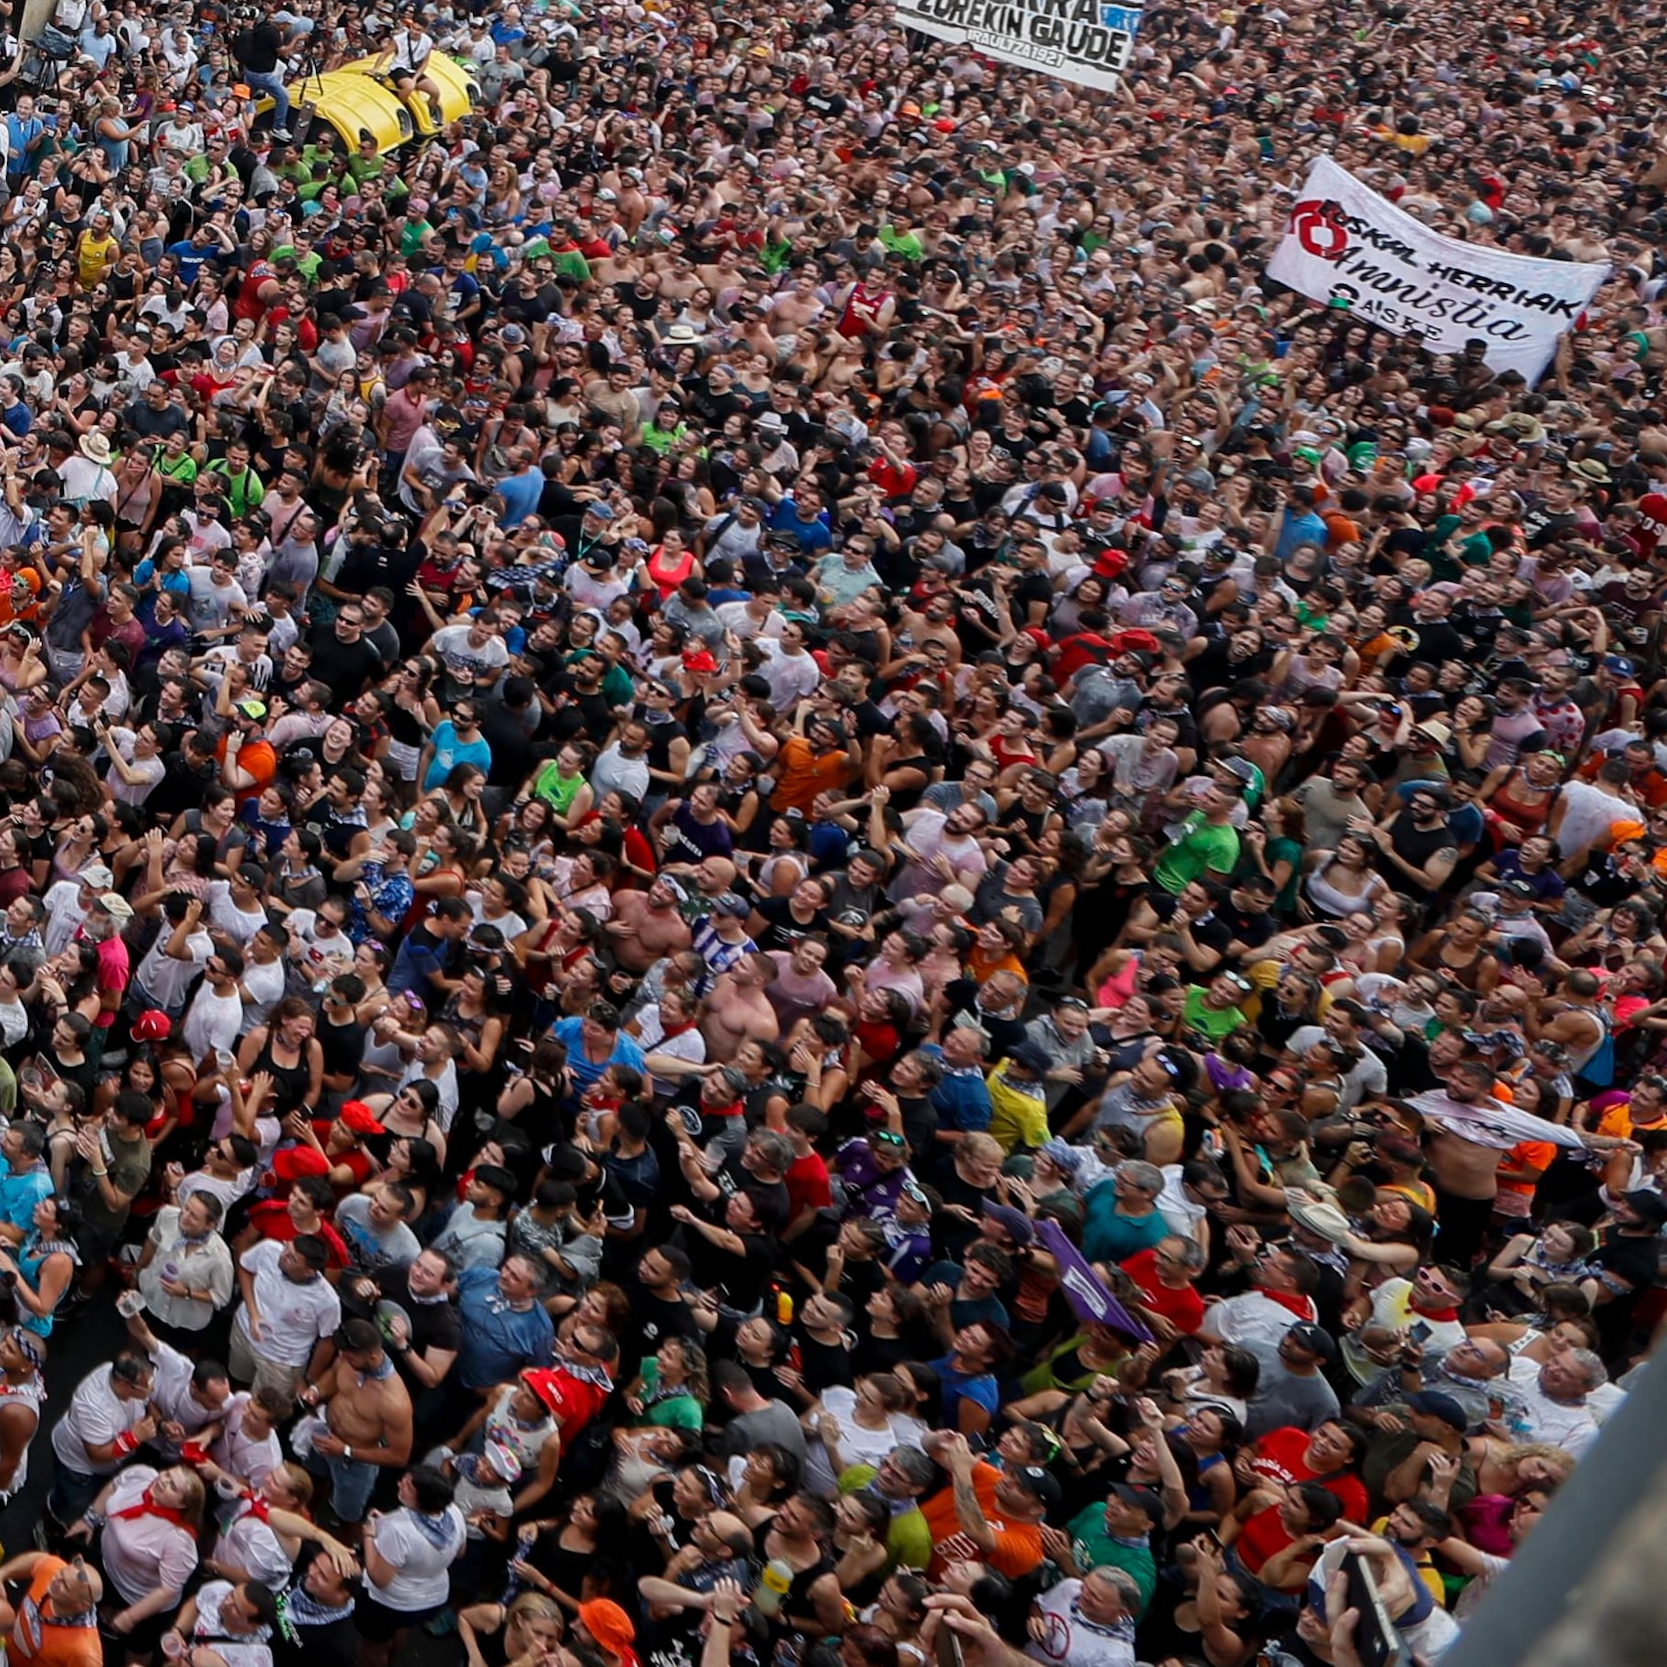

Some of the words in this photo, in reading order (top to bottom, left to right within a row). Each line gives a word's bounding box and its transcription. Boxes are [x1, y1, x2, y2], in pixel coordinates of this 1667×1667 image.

[1030, 15, 1128, 67] GAUDE
[1318, 199, 1418, 268] EUSKAL
[1427, 261, 1582, 319] HERRIAK
[1334, 246, 1532, 343] Amnistia
